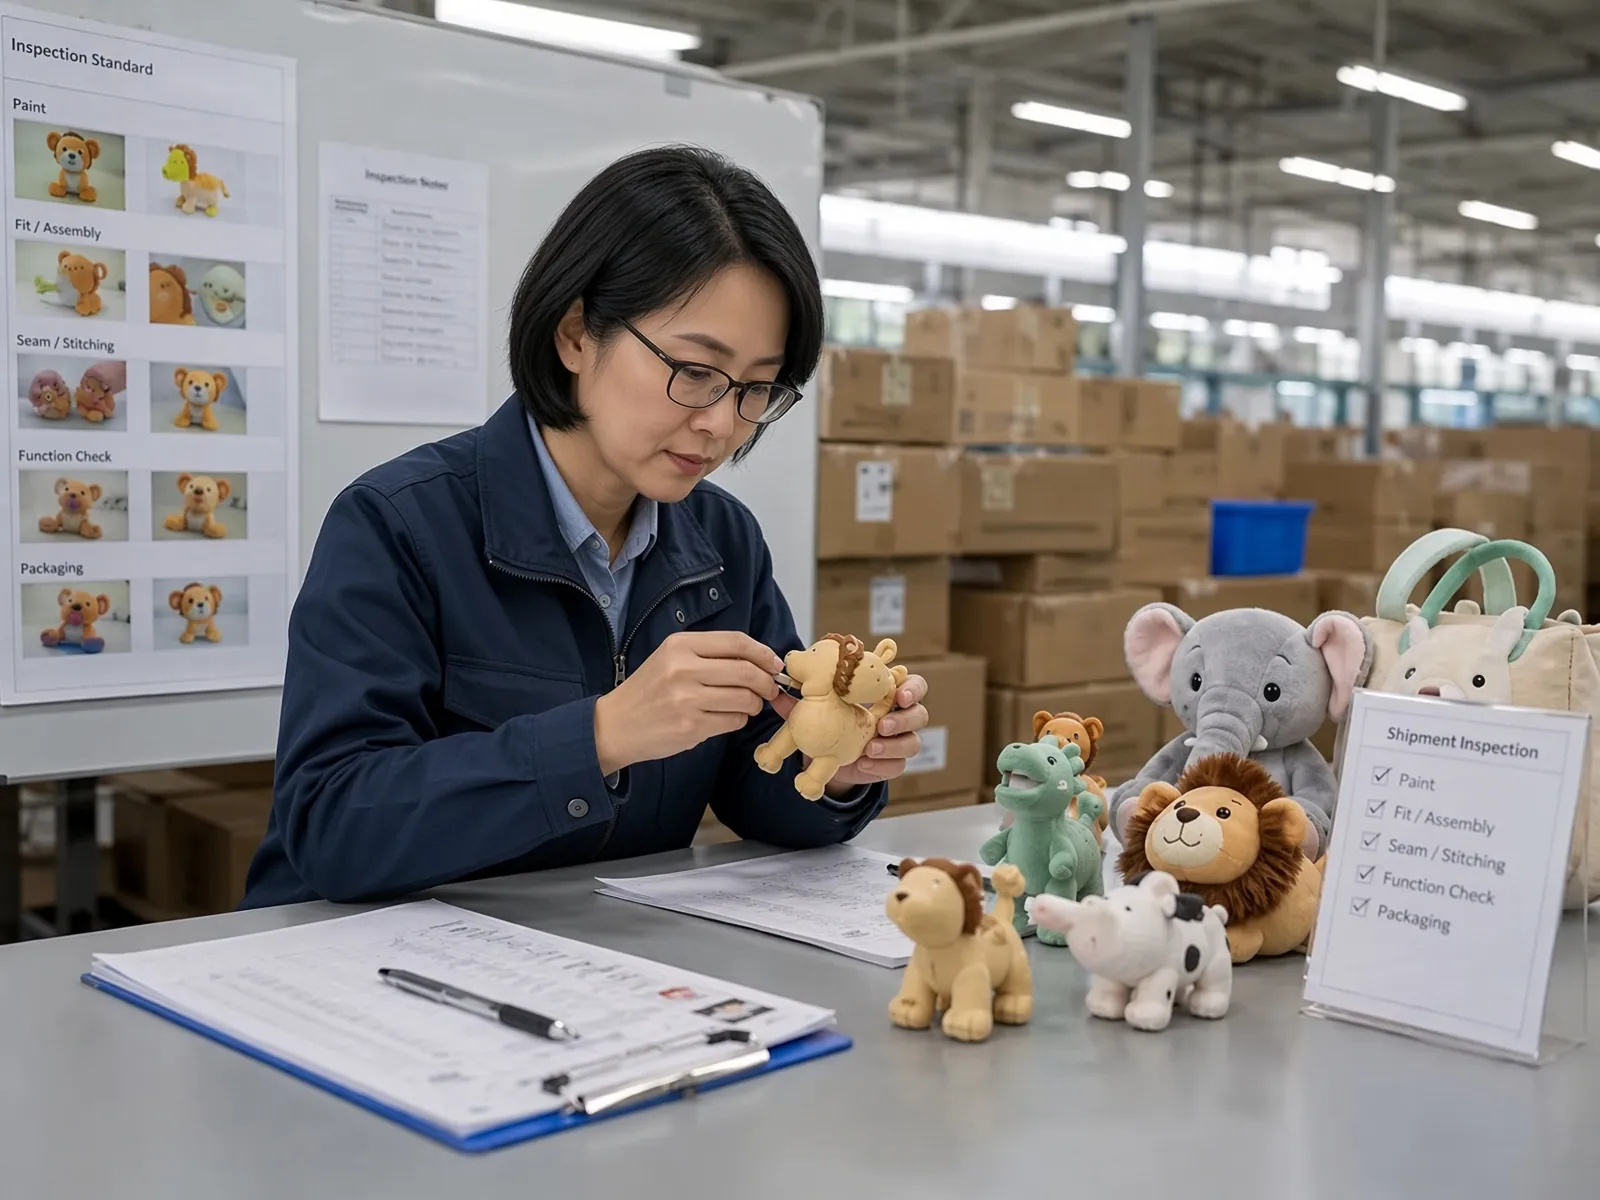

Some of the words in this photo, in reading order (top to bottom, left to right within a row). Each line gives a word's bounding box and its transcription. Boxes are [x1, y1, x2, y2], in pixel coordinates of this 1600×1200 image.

[11, 37, 87, 64] Inspection
[91, 53, 153, 75] Standard
[13, 98, 47, 114] Paint
[365, 169, 417, 185] Inspection
[15, 219, 31, 232] Fit
[34, 221, 40, 233] /
[43, 222, 102, 241] Assembly
[17, 334, 51, 347] Seam
[53, 336, 60, 349] /
[62, 337, 115, 354] Stitching
[18, 449, 72, 462] Function
[75, 450, 112, 462] Check
[20, 562, 84, 576] Packaging
[1386, 726, 1457, 748] Shipment
[1460, 736, 1539, 759] Inspection
[1399, 773, 1436, 792] Paint
[1393, 805, 1412, 822] Fit
[1413, 808, 1423, 824] /
[1424, 811, 1496, 838] Assembly
[1388, 838, 1428, 858] Seam
[1430, 845, 1440, 861] /
[1441, 848, 1507, 876] Stitching
[1383, 871, 1445, 896] Function
[1448, 884, 1496, 906] Check
[1377, 904, 1451, 935] Packaging
